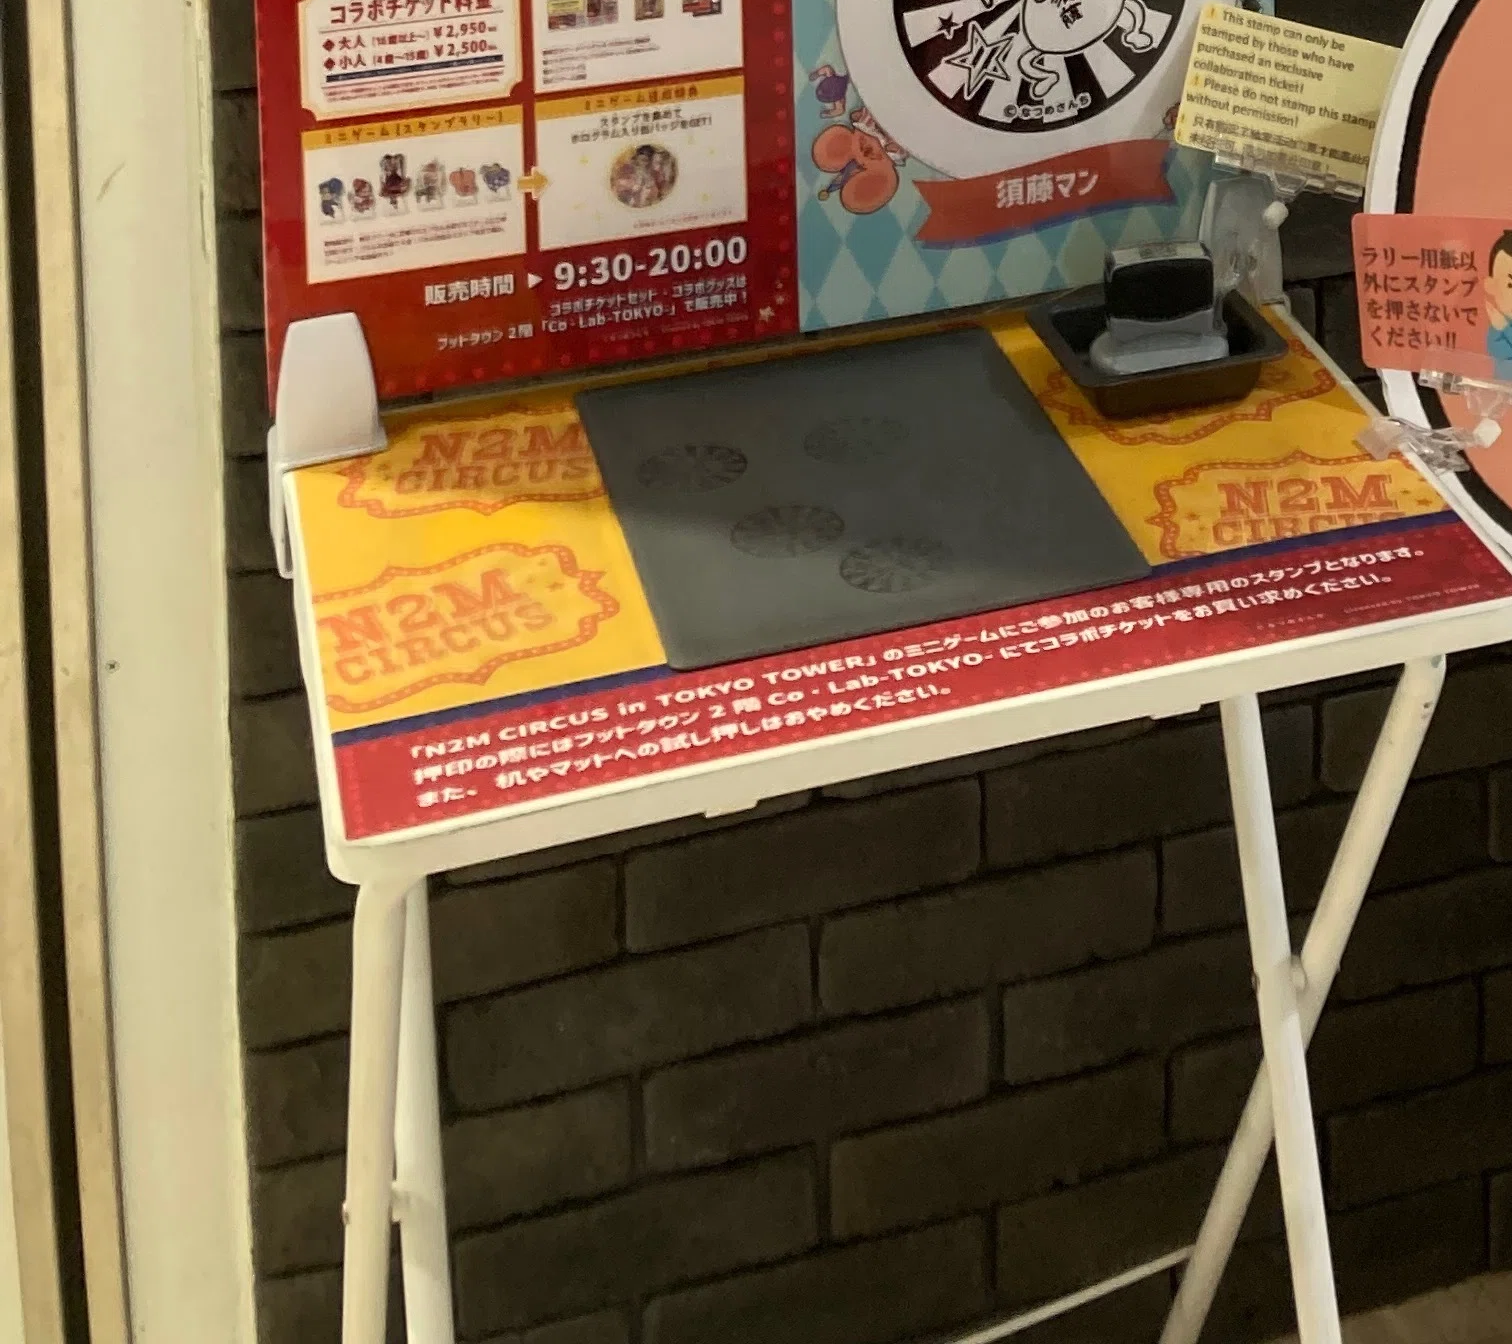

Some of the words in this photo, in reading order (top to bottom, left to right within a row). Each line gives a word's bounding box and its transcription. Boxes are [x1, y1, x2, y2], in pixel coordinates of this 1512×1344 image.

[1201, 24, 1250, 47] stamped
[1252, 36, 1266, 51] by
[1268, 40, 1299, 58] those
[1301, 50, 1326, 65] who
[1328, 55, 1355, 72] have
[1222, 10, 1244, 26] This
[1246, 18, 1281, 36] stamp
[1283, 28, 1302, 41] can
[1305, 32, 1329, 50] only
[1331, 38, 1345, 52] be
[1193, 59, 1266, 85] collaboration
[1197, 40, 1256, 64] purchased
[1258, 57, 1271, 69] an
[1274, 61, 1324, 81] exclusive
[1186, 91, 1230, 112] without
[1232, 103, 1299, 127] permission!
[1204, 77, 1240, 96] Please
[1242, 86, 1257, 101] do
[1259, 92, 1279, 108] not
[1281, 97, 1316, 115] stamp
[1318, 105, 1339, 121] this
[1341, 111, 1376, 130] stamp
[996, 168, 1099, 209] 須藤マン
[425, 273, 515, 306] 販売時間
[554, 236, 747, 291] 9:30-20:00
[1362, 246, 1478, 272] ラリー用紙以
[1363, 272, 1479, 298] 外にスタンプ
[1366, 298, 1478, 327] を押さないで
[413, 422, 590, 467] N2M
[395, 456, 597, 495] CIRCUS
[1217, 474, 1399, 518] N2M
[316, 568, 523, 654] N2M
[334, 601, 554, 685] CIRCUS
[498, 707, 609, 741] CIRCUS
[617, 700, 647, 716] in
[655, 677, 755, 707] TOKYO
